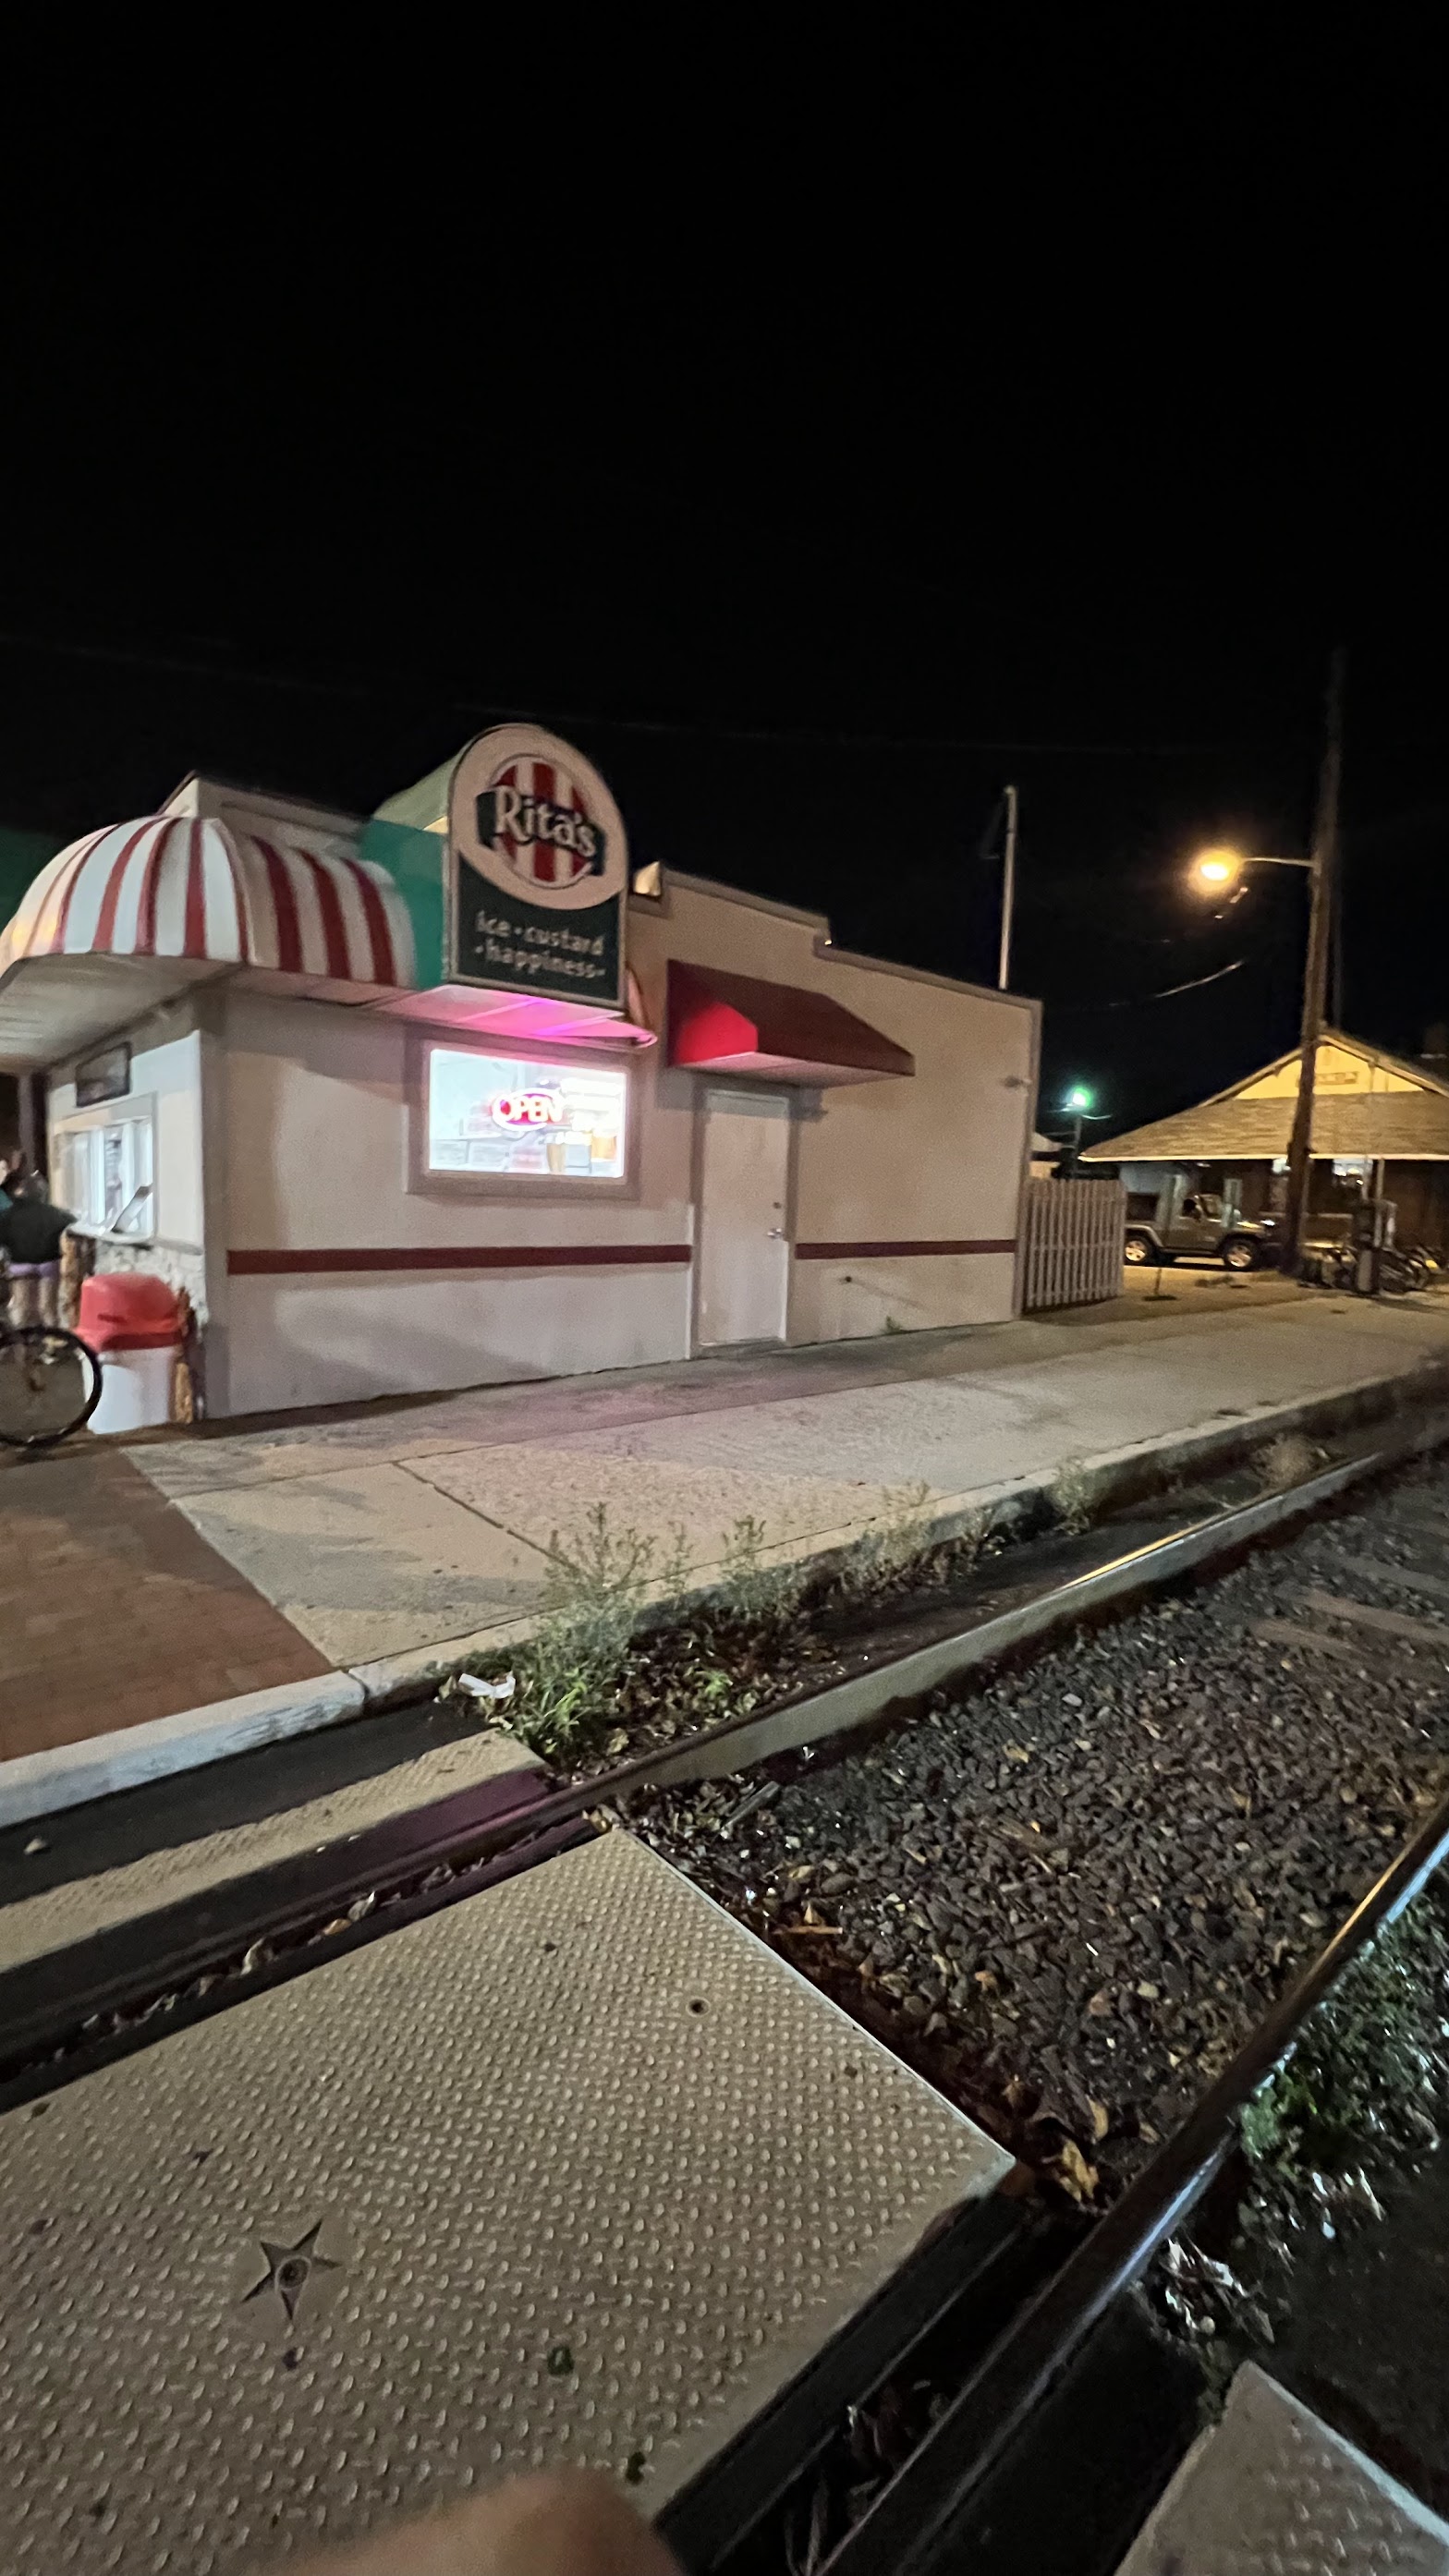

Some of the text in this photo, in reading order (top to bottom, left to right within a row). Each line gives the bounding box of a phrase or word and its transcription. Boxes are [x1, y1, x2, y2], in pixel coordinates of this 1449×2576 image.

[493, 784, 597, 857] Rita's
[523, 926, 605, 956] custard
[494, 1094, 564, 1123] OPEN
